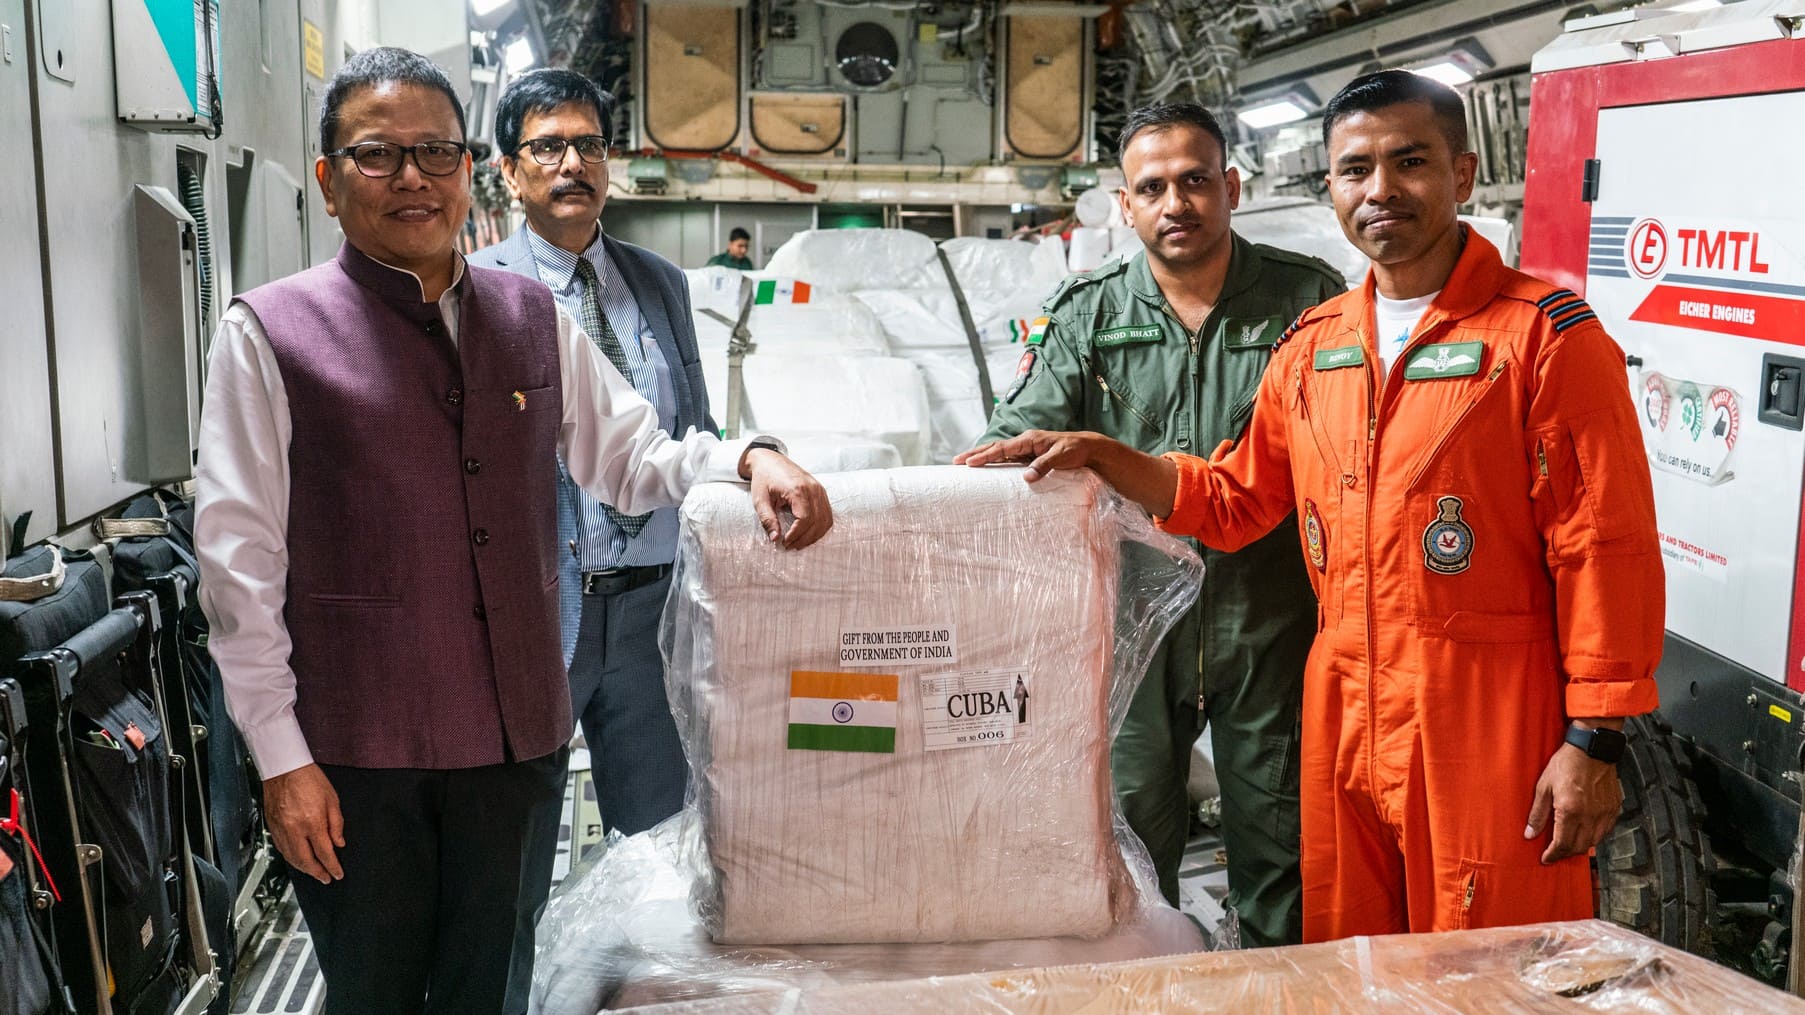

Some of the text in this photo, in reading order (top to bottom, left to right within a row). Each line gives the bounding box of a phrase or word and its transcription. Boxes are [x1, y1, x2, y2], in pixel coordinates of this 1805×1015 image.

[1678, 229, 1769, 273] TMTL
[1679, 300, 1756, 325] EICHER ENGINES
[1098, 328, 1160, 342] VINOD BHATT
[1713, 391, 1729, 405] MOST
[1668, 455, 1679, 466] can
[1680, 458, 1692, 474] rely
[1693, 462, 1701, 474] on
[1666, 535, 1677, 546] AND
[1678, 540, 1705, 557] TRACTORS
[1705, 551, 1728, 566] LIMITED
[842, 629, 950, 645] GIFT FROM THE PEOPLE AND
[841, 645, 953, 661] GOVERNMENT OF INDIA
[947, 690, 1012, 718] CUBA
[978, 730, 1004, 740] 006
